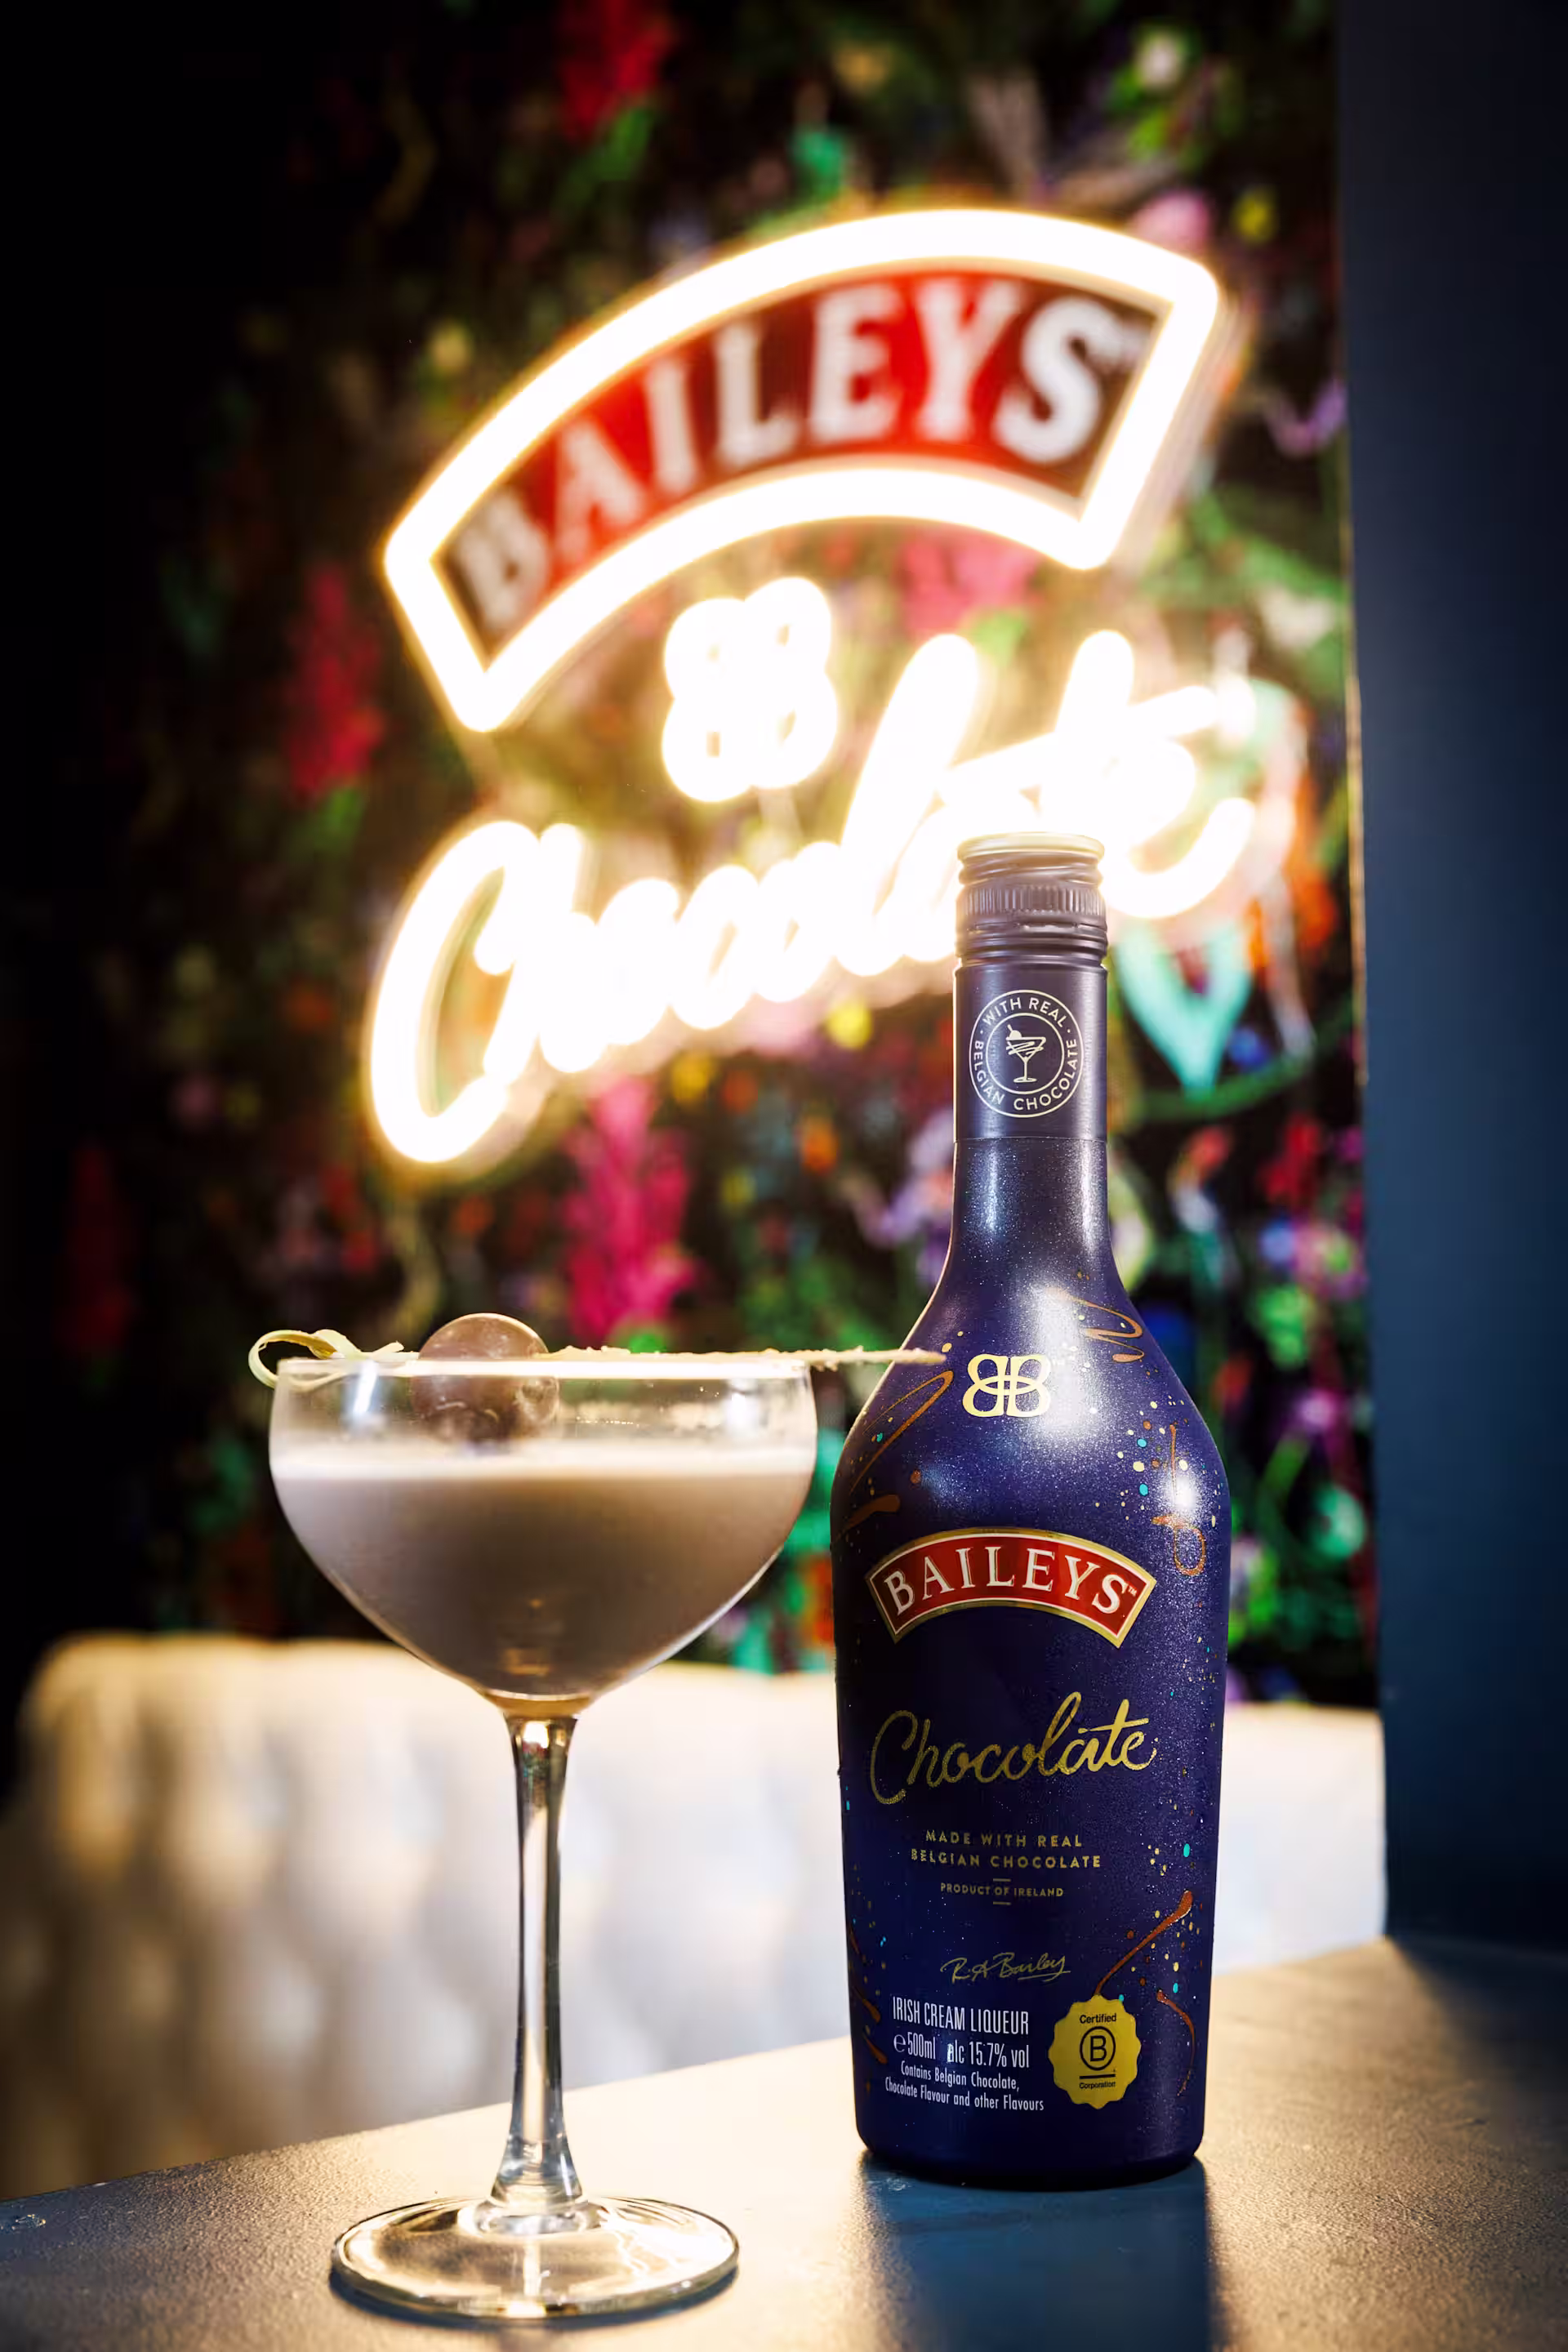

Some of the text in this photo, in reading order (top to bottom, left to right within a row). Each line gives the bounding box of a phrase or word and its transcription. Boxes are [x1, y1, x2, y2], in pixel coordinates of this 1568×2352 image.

[451, 277, 1124, 627] BAILEYS
[982, 996, 1067, 1028] WITH REAL
[973, 1038, 1078, 1111] BELGIAN CHOCOLATE
[870, 1691, 1158, 1805] Chocolate
[925, 1829, 1082, 1847] MADE WITH REAL
[911, 1848, 1101, 1869] BELGIAN CHOCOLATE
[940, 1882, 1064, 1897] PRODUCT OF IRELAND
[893, 1996, 1029, 2035] IRISH CREAM LIQUEUR
[1079, 2012, 1117, 2025] Certified
[947, 2038, 965, 2065] alc
[969, 2041, 1007, 2068] 15.7%
[1011, 2044, 1030, 2069] vol
[1089, 2034, 1107, 2062] B
[900, 2060, 1020, 2092] Contains Belgian Chocolate,
[1079, 2081, 1116, 2090] Corporation
[884, 2076, 1045, 2111] Chocolate Flavour and other Flavours
